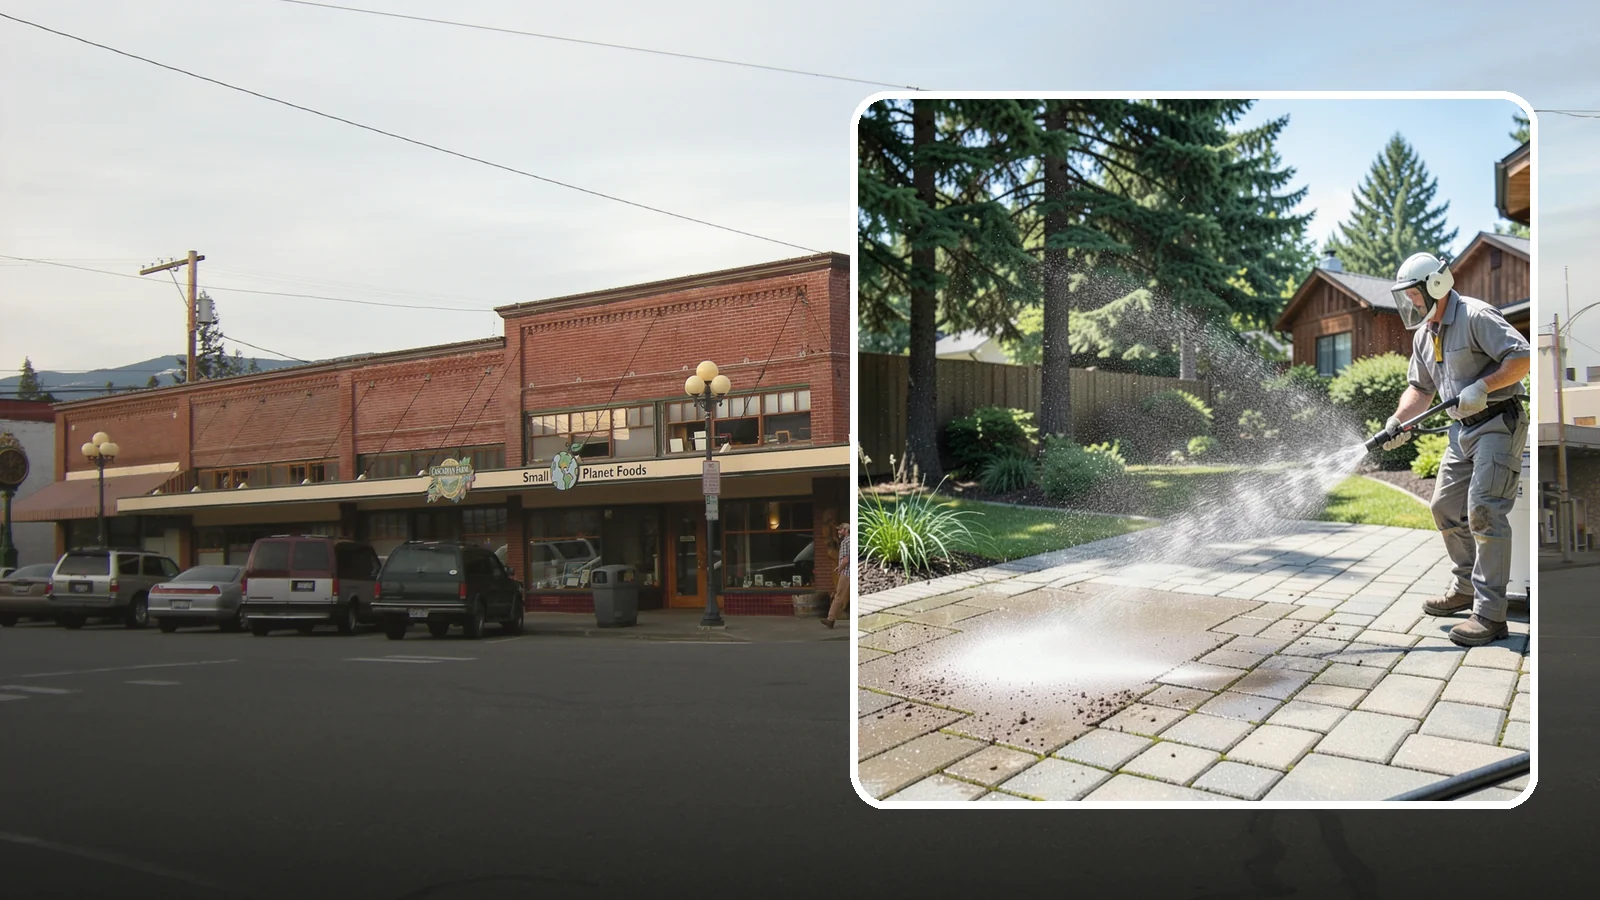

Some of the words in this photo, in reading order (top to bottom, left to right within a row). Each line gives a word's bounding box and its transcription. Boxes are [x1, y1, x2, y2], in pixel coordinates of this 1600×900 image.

[523, 471, 549, 483] Small
[583, 467, 614, 480] Planet
[617, 464, 647, 477] Foods
